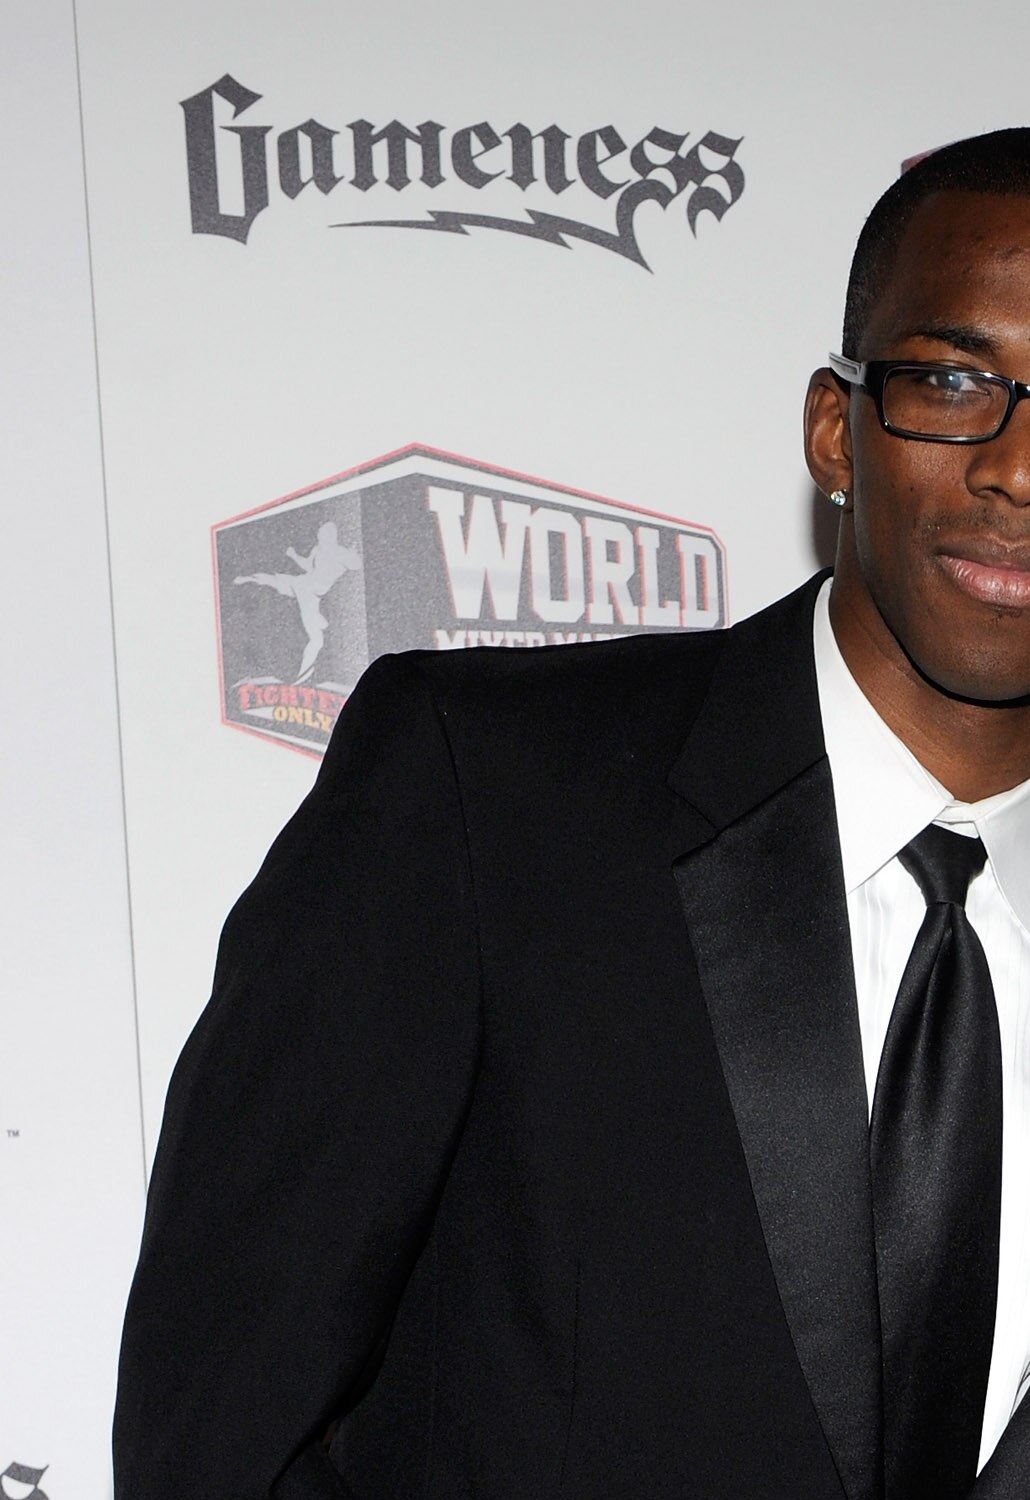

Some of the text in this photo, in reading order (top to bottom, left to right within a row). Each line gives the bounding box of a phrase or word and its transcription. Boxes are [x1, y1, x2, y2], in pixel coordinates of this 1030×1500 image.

[178, 73, 746, 250] Gameness
[427, 485, 720, 629] WORLD
[273, 706, 333, 731] ONLY
